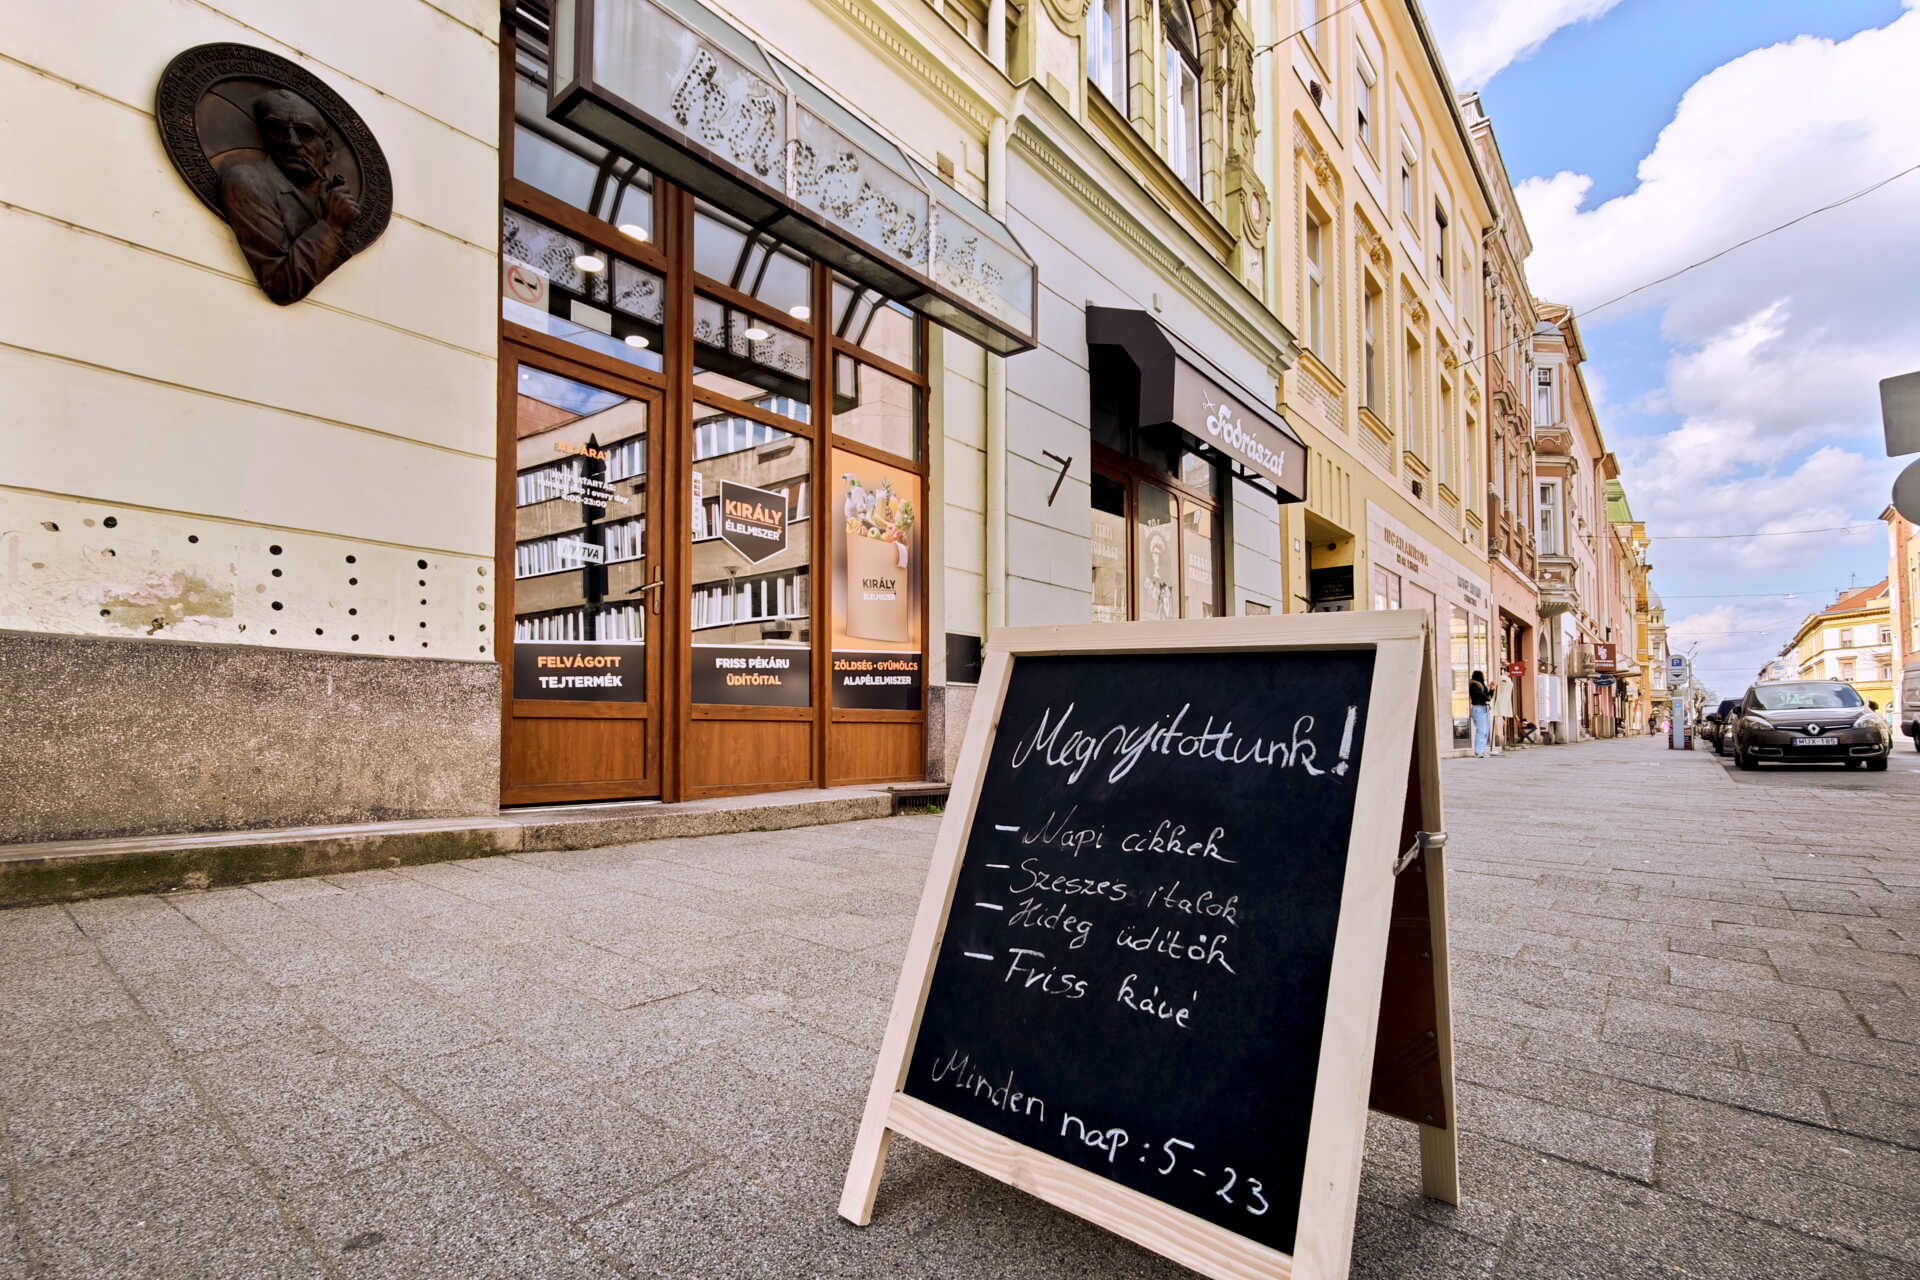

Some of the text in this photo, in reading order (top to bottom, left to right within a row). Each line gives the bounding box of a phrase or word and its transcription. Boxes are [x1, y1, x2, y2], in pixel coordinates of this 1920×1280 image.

[1206, 403, 1285, 477] Fodrászat
[725, 499, 782, 525] KIRÁLY
[725, 518, 780, 541] ÉLELMISZER
[560, 541, 600, 560] NYTVA
[862, 576, 896, 590] KIRÁLY
[537, 653, 622, 668] FELVÁGOTT
[715, 656, 790, 669] FRISS PÉKÁRU
[833, 659, 873, 671] ZÖLDSÉG
[538, 673, 623, 689] TEJTERMÉK
[726, 672, 782, 686] ÜDÍTŐITAL
[843, 674, 912, 686] ALAPÉLELMISZER
[1022, 804, 1238, 864] Napi cikkek
[1009, 857, 1240, 928] Szeszes italok
[1008, 897, 1093, 950] Hideg
[1005, 947, 1200, 1029] Friss kávé
[931, 1048, 1045, 1123] Minden
